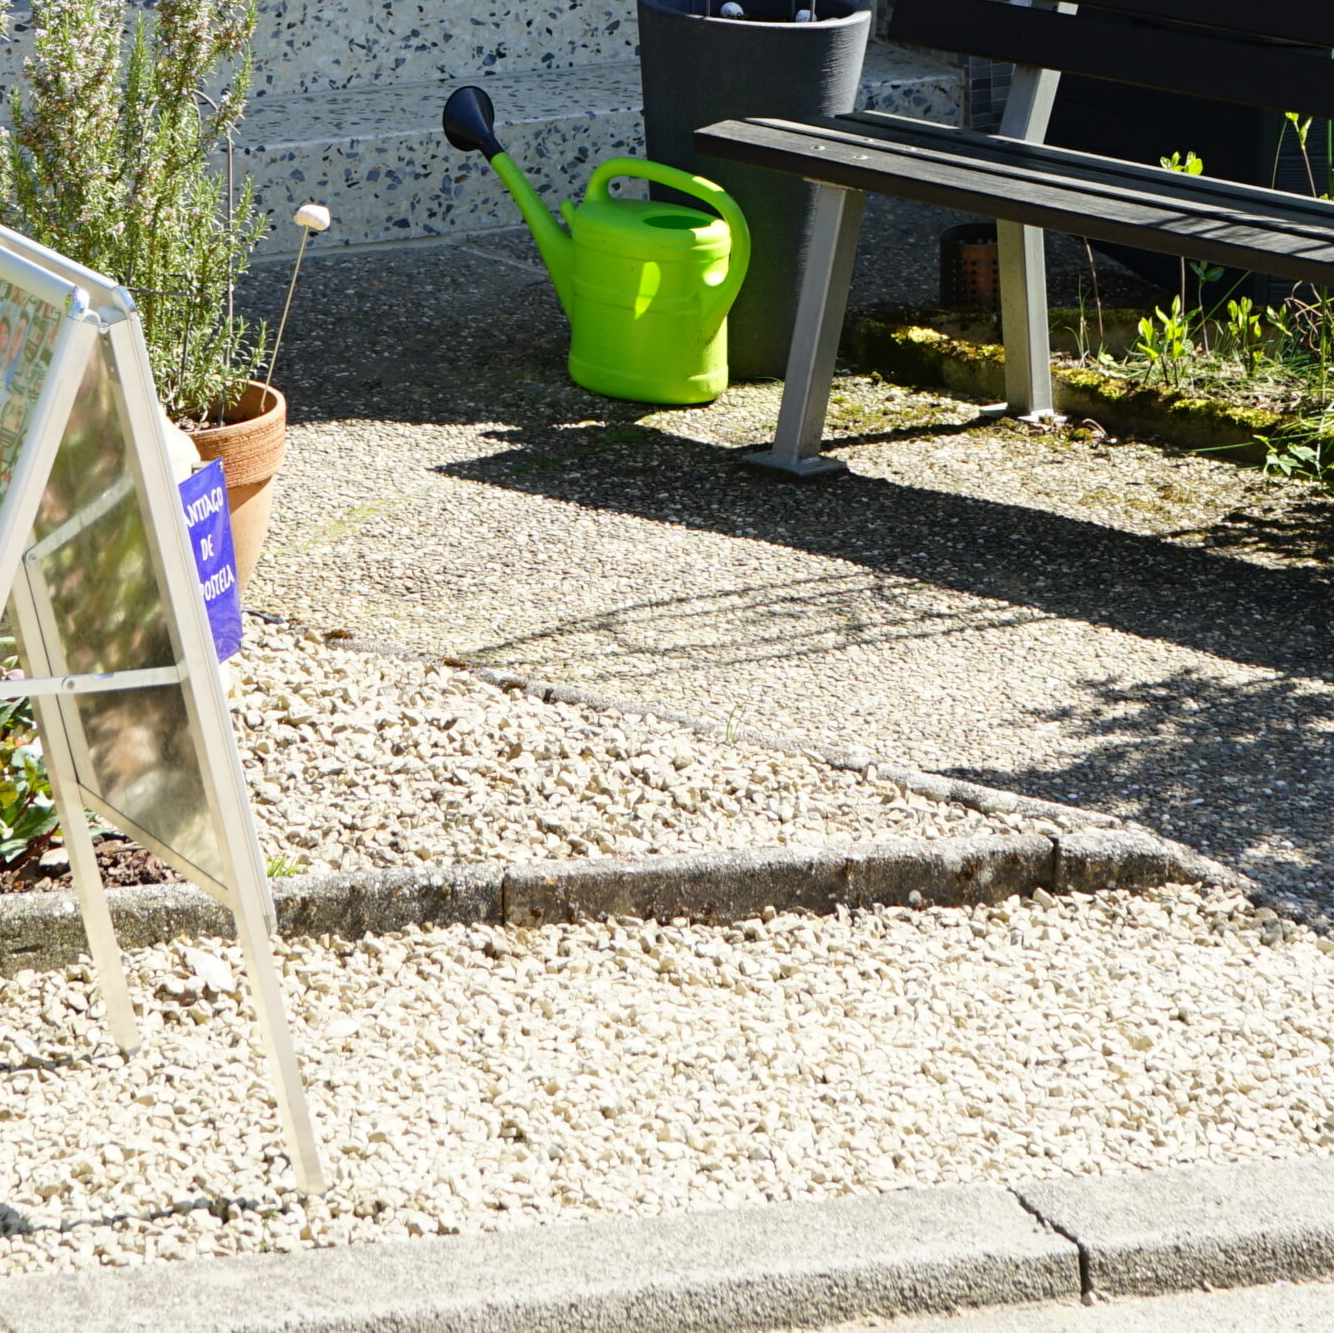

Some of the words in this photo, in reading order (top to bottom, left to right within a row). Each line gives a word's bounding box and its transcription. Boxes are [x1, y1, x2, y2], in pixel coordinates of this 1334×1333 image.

[183, 486, 224, 528] ANTIAGO
[200, 534, 215, 561] DE
[199, 564, 235, 601] POSTELA
